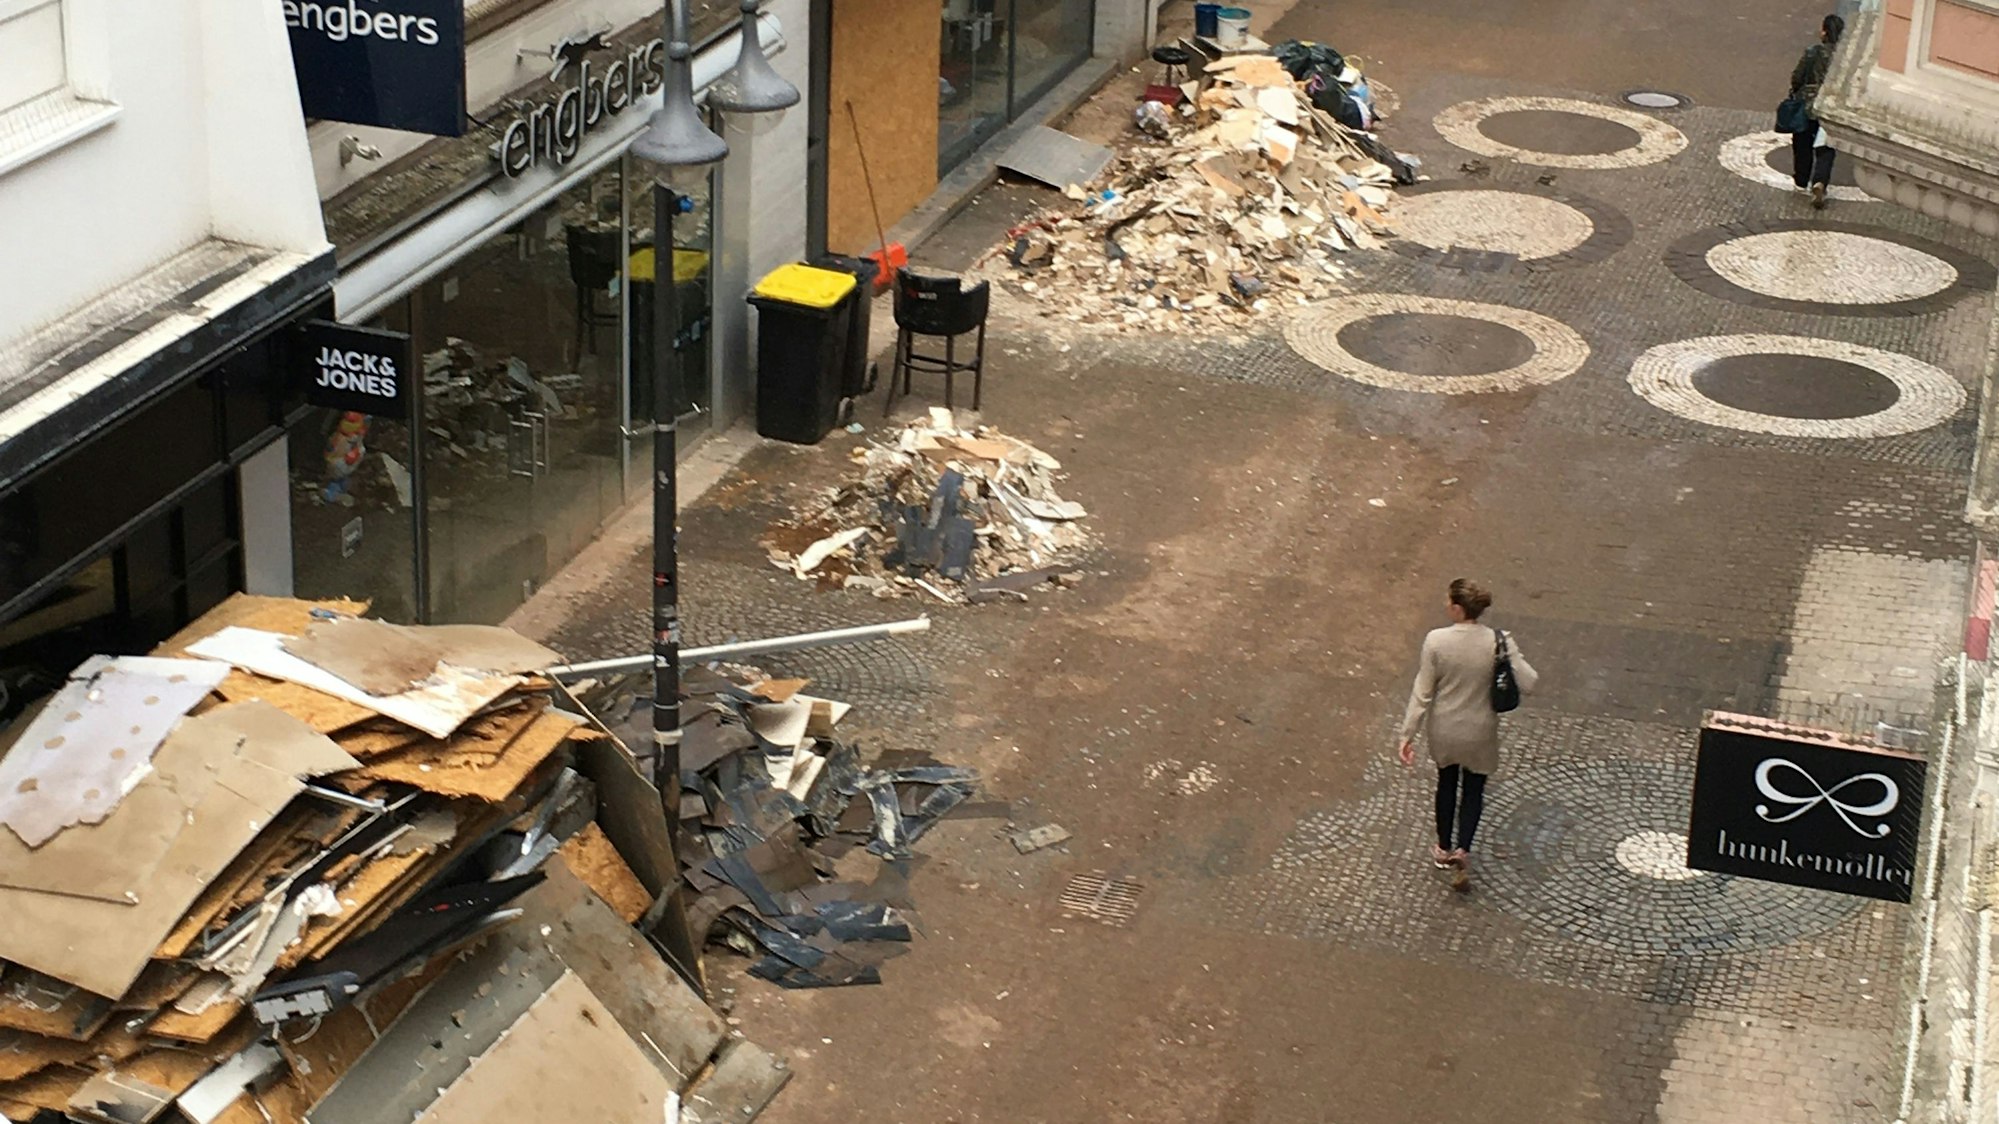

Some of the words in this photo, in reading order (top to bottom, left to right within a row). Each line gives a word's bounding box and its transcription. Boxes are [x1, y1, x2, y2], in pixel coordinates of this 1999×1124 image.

[282, 0, 440, 46] engbers
[502, 38, 665, 178] engbers
[315, 346, 396, 377] JACK&
[315, 367, 397, 398] JONES
